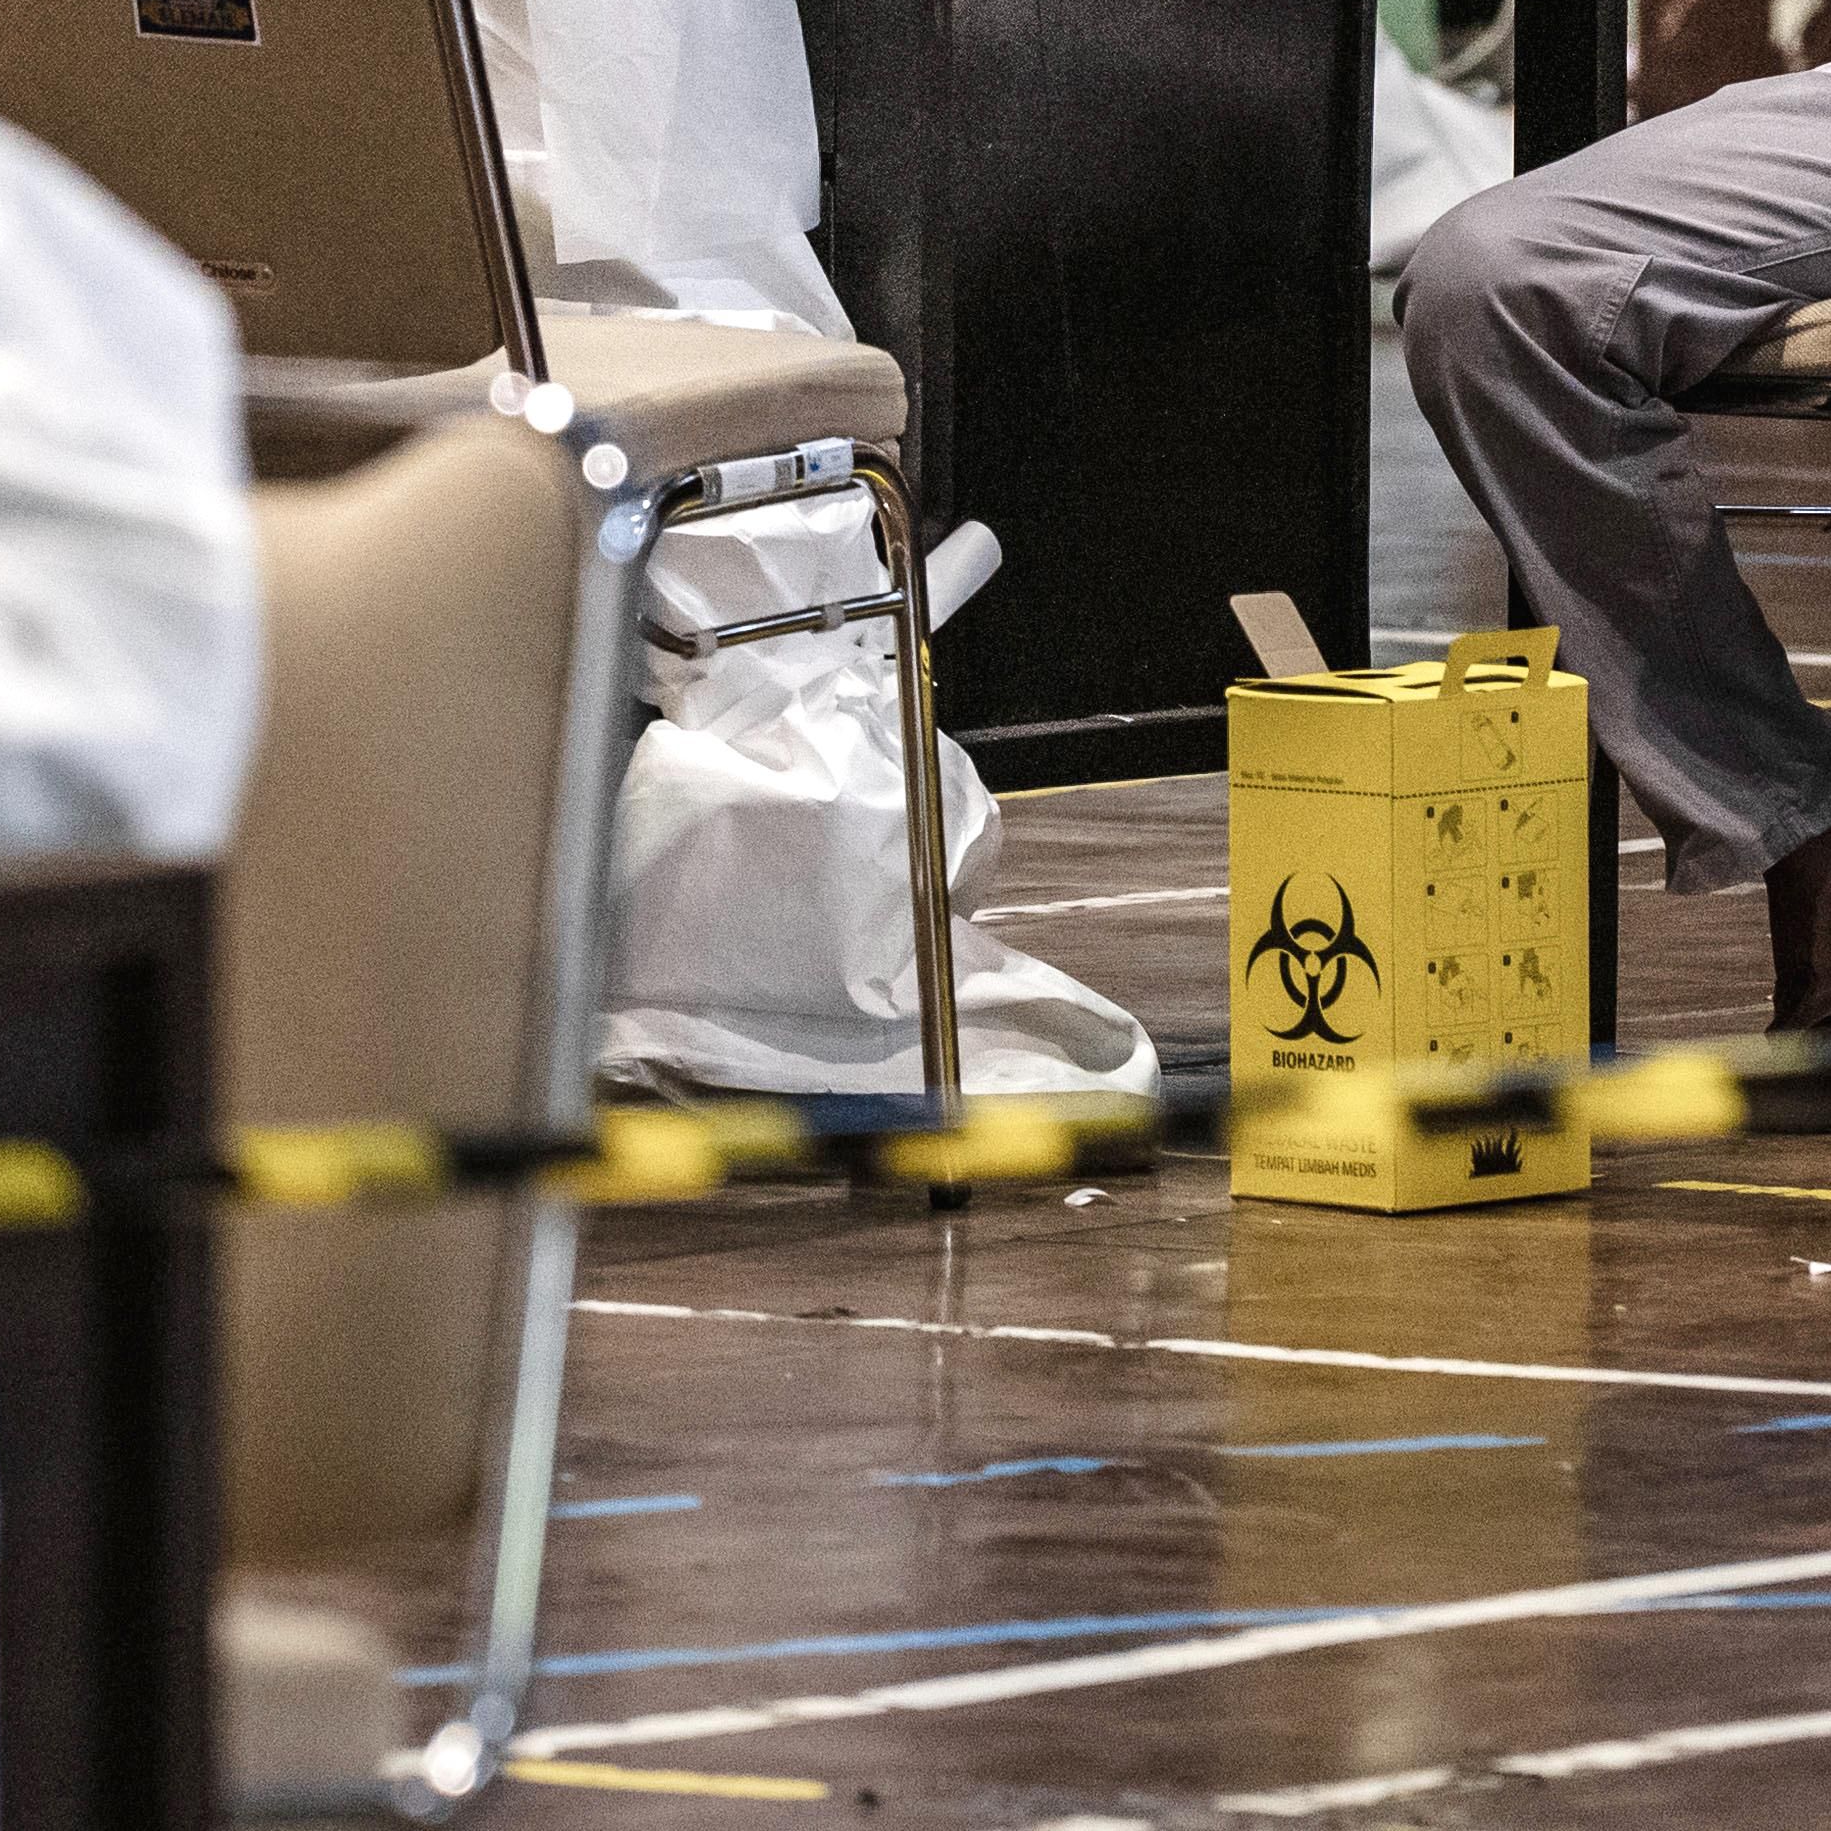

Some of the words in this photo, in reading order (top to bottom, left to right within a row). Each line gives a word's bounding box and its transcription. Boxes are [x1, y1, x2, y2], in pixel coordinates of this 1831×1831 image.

[1272, 1050, 1355, 1072] BIOHAZARD
[1253, 1153, 1294, 1172] TEMPAT
[1298, 1158, 1340, 1176] LIMBAH
[1342, 1161, 1377, 1178] MEDIS
